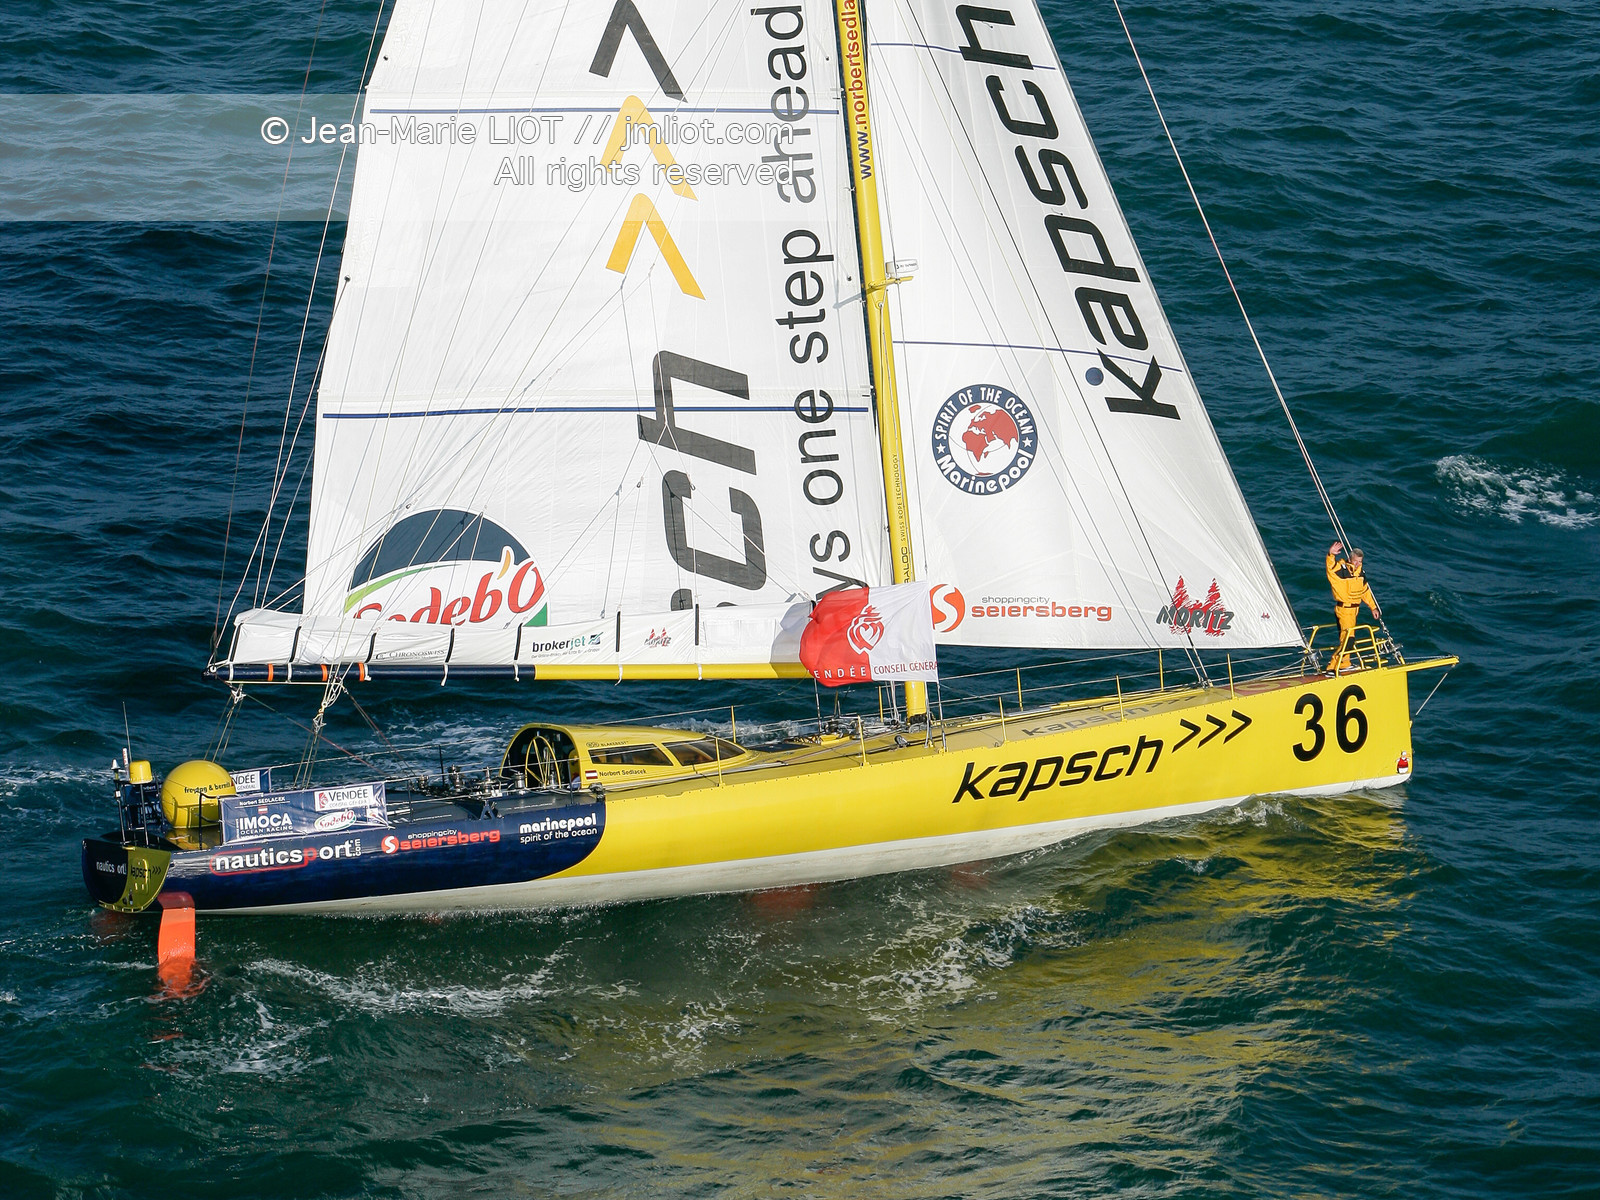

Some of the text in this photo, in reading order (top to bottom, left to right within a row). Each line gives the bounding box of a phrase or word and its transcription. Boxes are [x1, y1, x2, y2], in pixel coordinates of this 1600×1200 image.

[750, 5, 816, 203] ahead
[956, 4, 1181, 421] kapsch
[775, 229, 834, 363] step
[935, 387, 1034, 440] SPIRIT OF THE OCEAN
[794, 389, 843, 506] one
[892, 454, 902, 499] TECHNOLOGY
[937, 448, 1034, 492] Marinepool
[971, 602, 1112, 621] seiersberg
[982, 596, 1050, 604] shoppingcity
[1156, 605, 1234, 630] MORITZ
[532, 636, 586, 652] brokerjet
[873, 664, 908, 675] CONSEIL
[1292, 684, 1368, 762] 36
[952, 734, 1163, 802] kapsch
[328, 788, 369, 801] VENDÉE
[240, 813, 292, 830] IMOCA
[519, 813, 597, 834] marinepool
[400, 829, 500, 850] seiersberg
[408, 829, 457, 840] shoppingcity
[520, 828, 598, 844] spirit of the ocean
